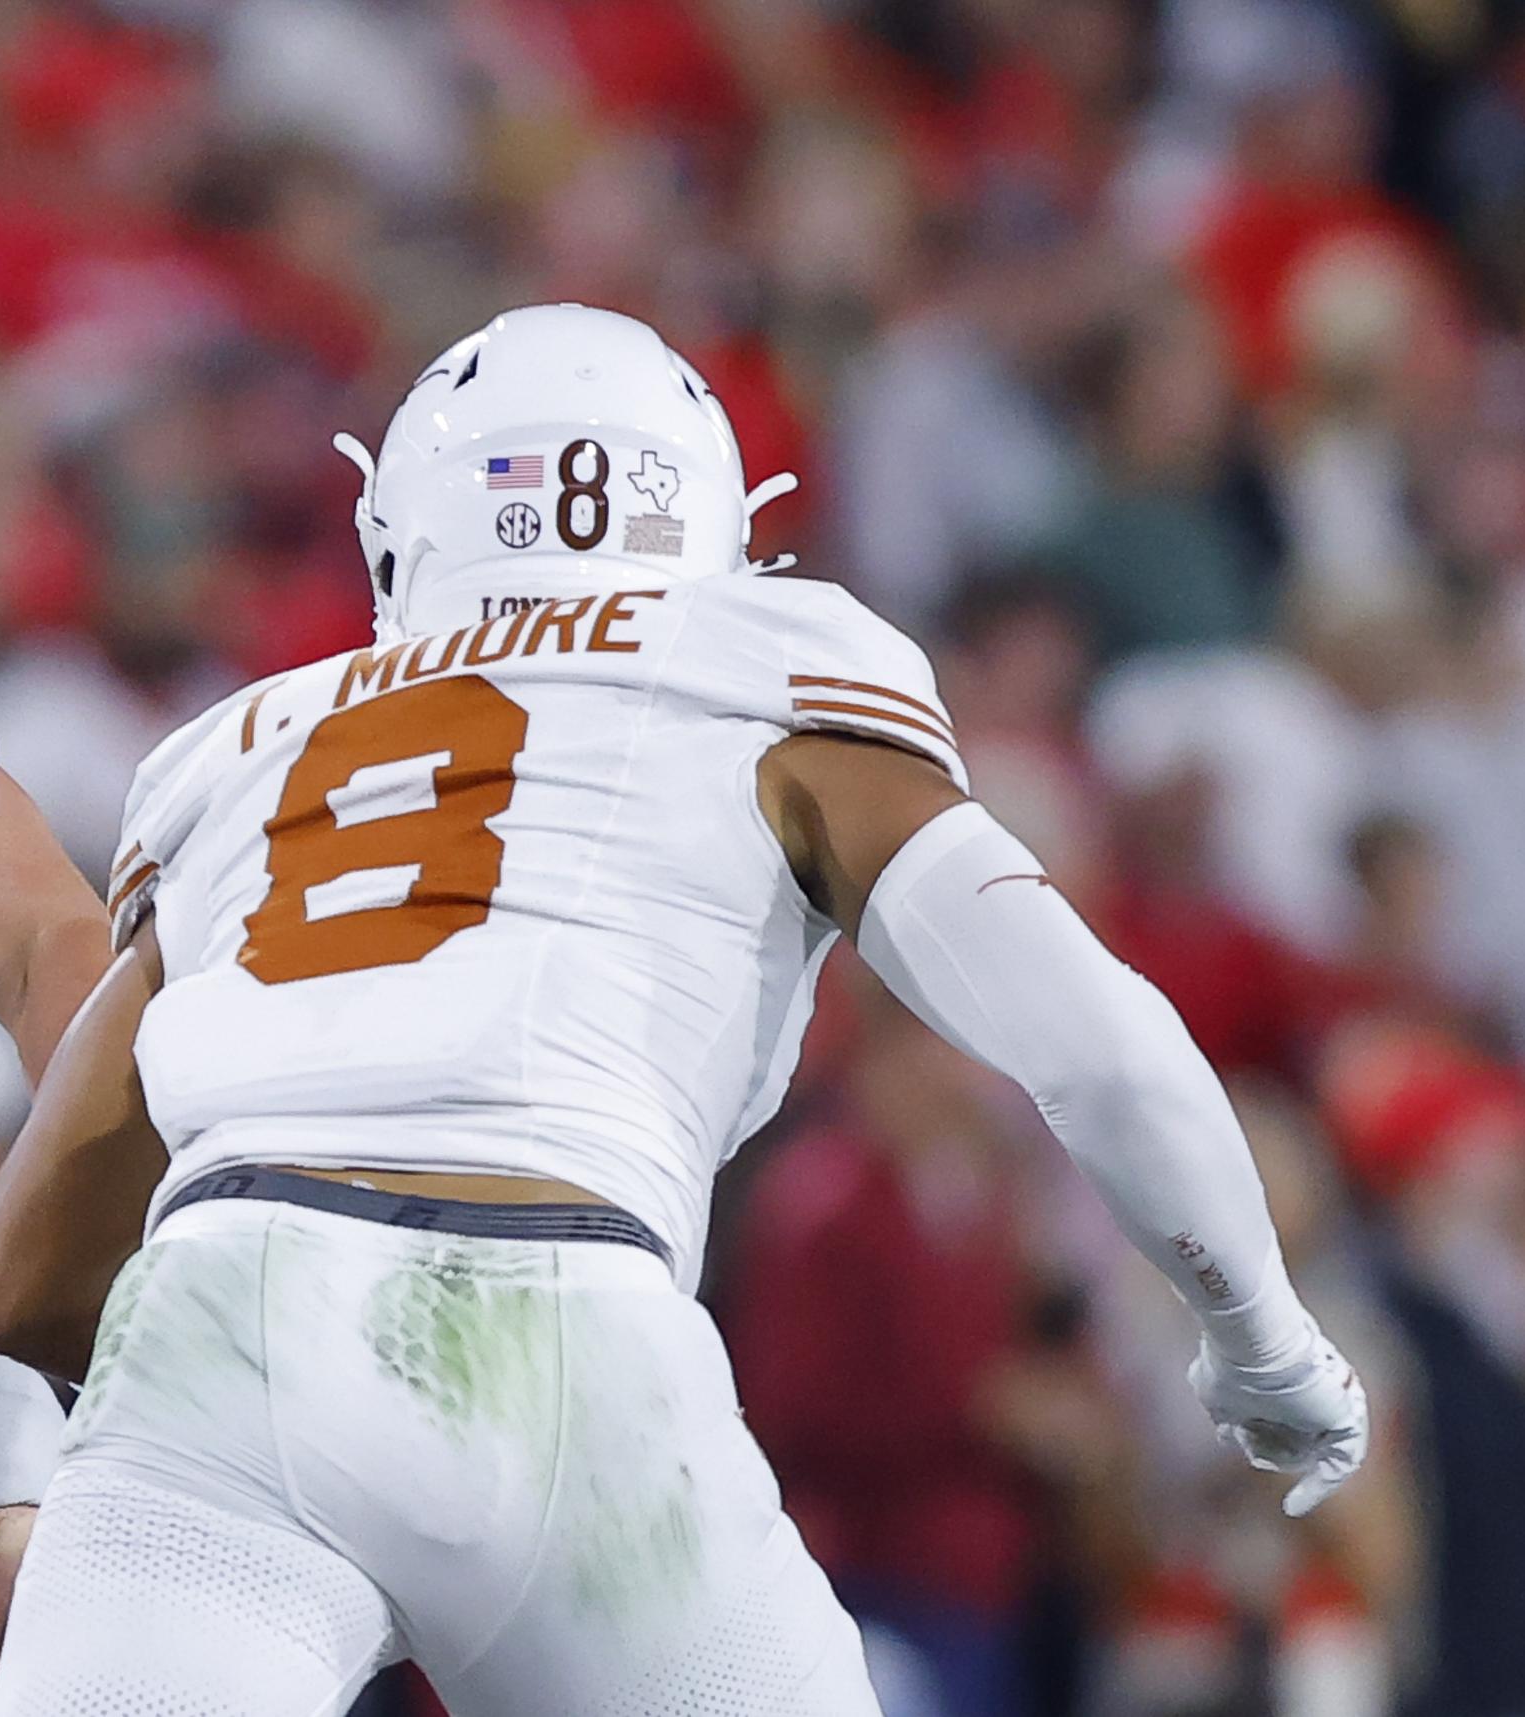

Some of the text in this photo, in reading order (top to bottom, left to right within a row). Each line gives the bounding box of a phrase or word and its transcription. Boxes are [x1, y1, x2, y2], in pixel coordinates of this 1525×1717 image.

[497, 503, 540, 548] SEC
[556, 438, 610, 551] 8
[236, 673, 530, 986] 8
